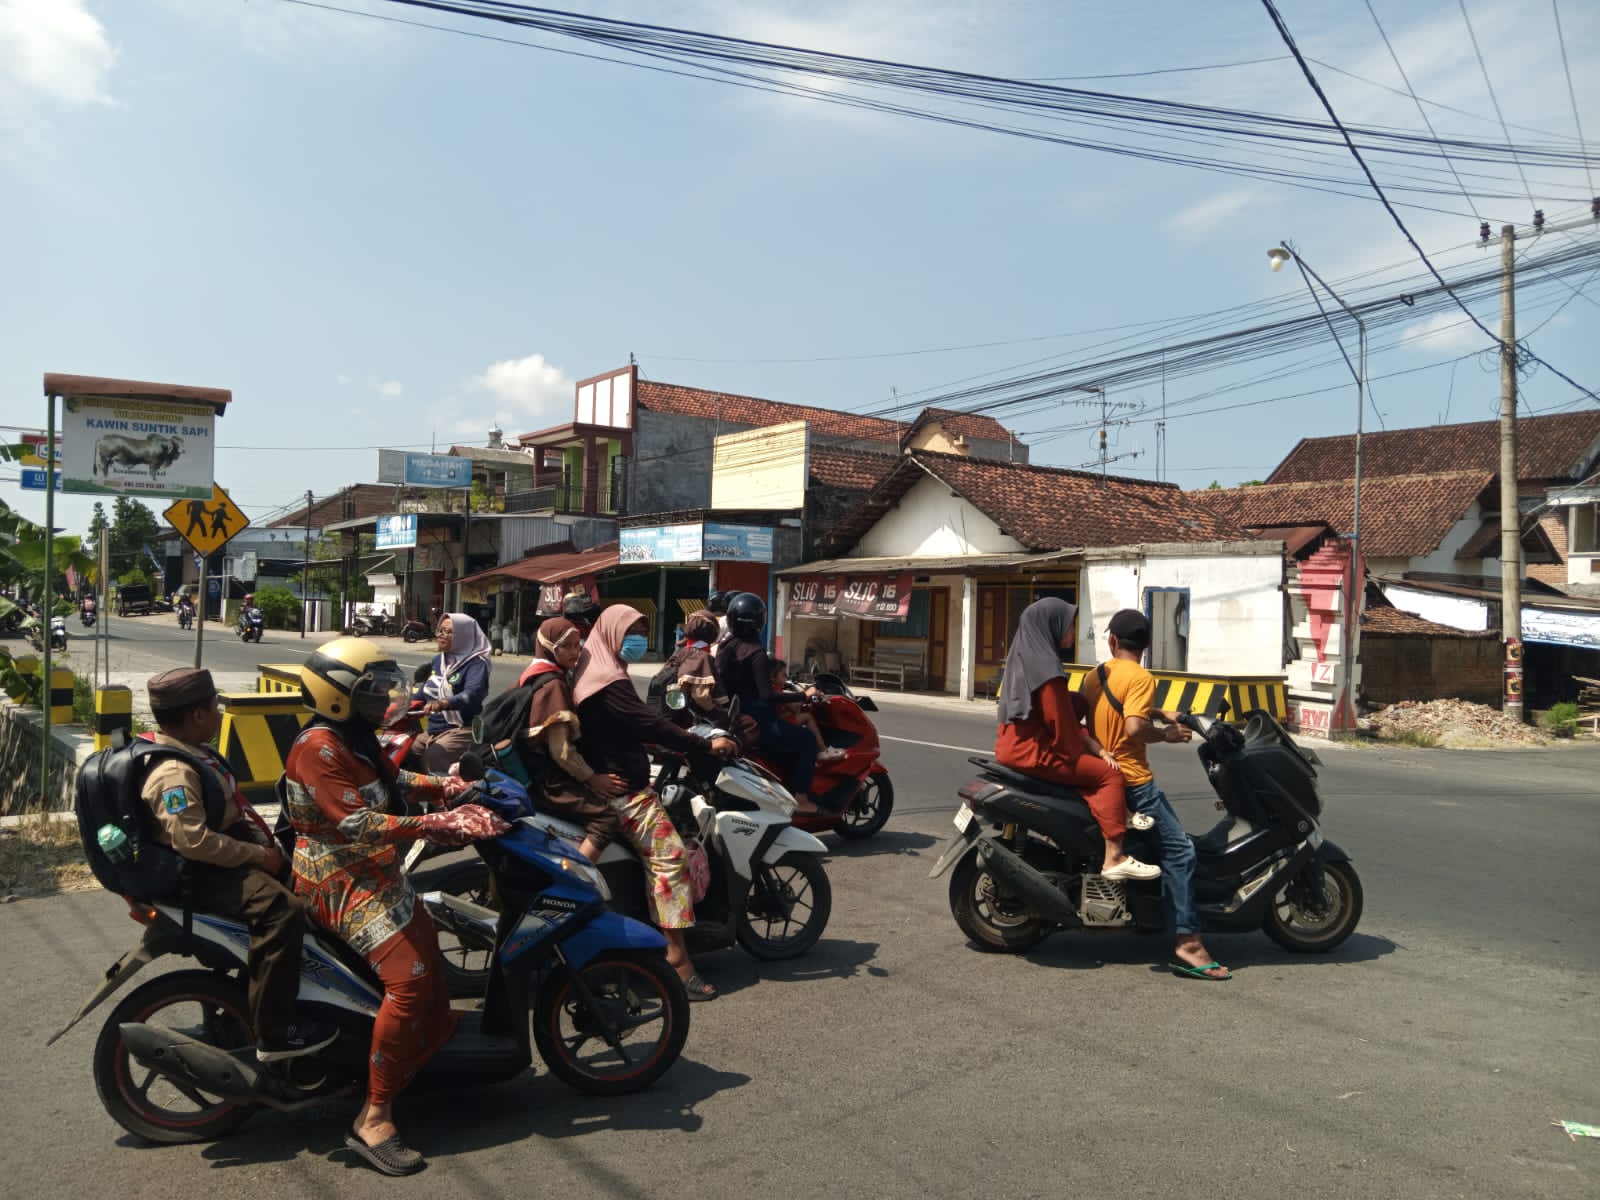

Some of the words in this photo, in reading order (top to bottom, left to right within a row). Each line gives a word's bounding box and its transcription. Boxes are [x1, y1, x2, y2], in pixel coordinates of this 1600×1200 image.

[86, 418, 129, 431] KAWIN
[132, 422, 178, 434] SUNTIK
[181, 426, 208, 437] SAPI
[542, 898, 577, 910] HONDA
